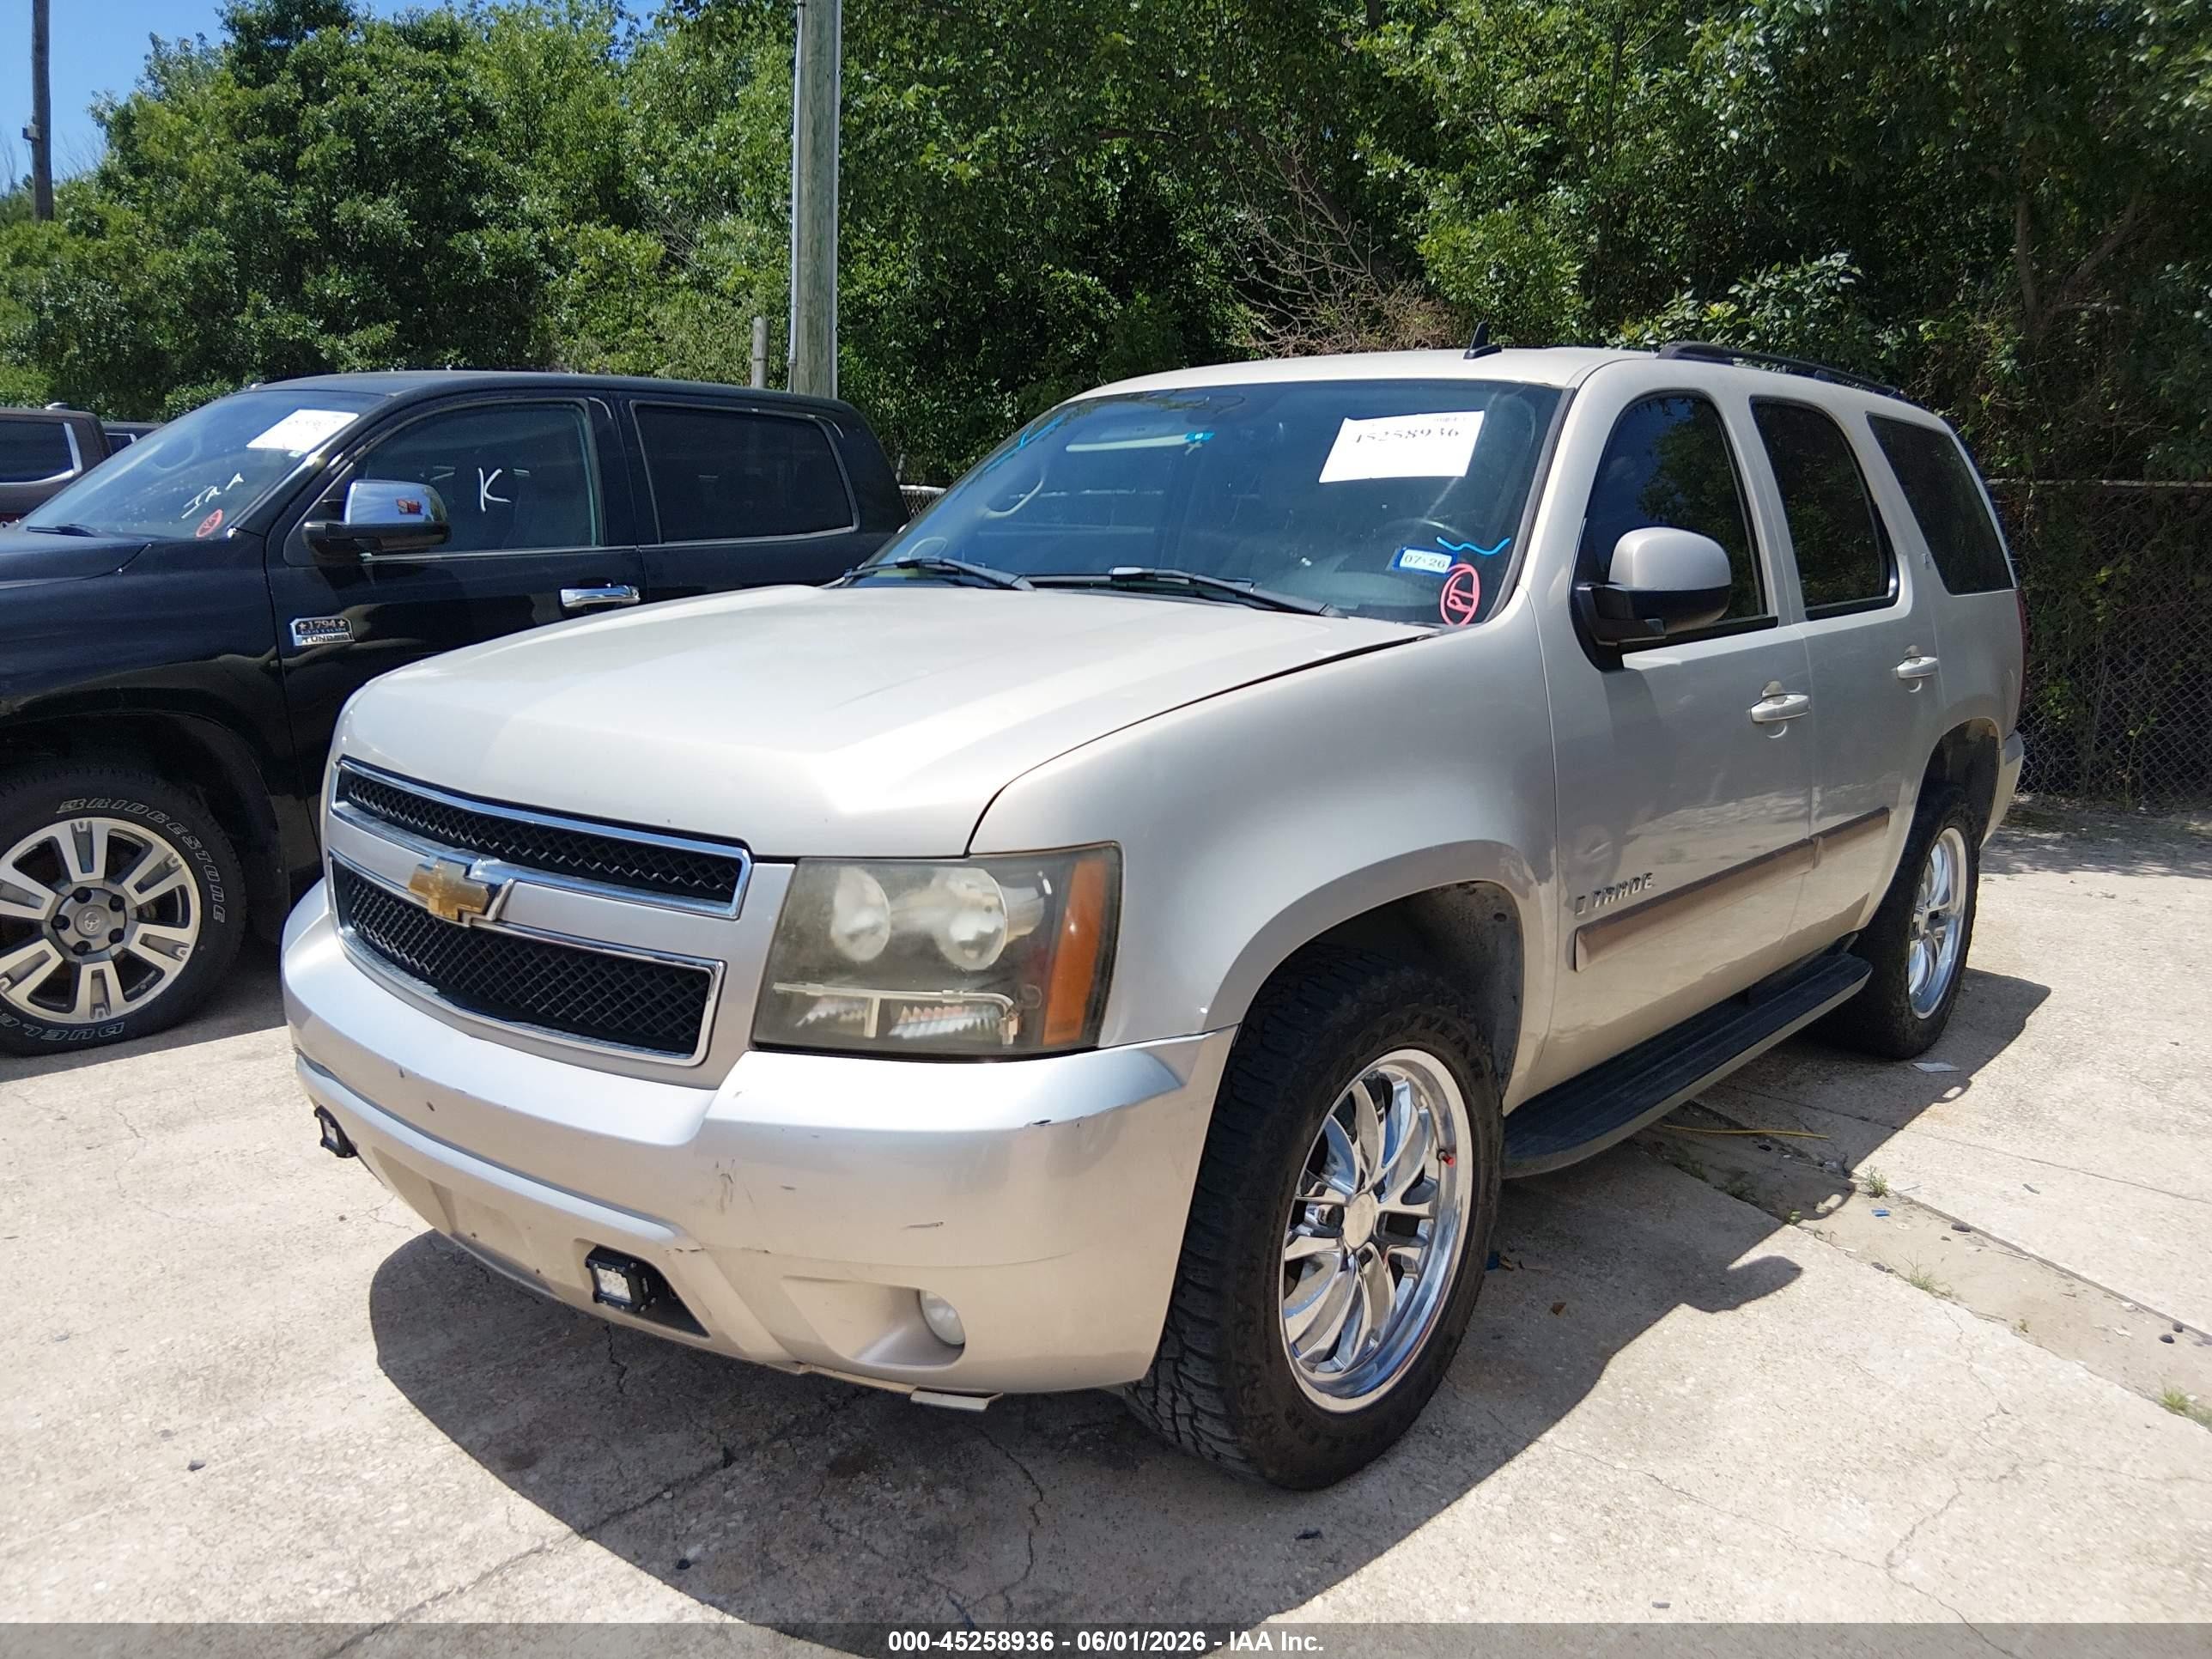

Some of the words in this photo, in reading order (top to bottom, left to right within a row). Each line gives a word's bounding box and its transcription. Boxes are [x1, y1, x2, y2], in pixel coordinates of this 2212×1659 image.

[477, 467, 512, 513] K
[307, 619, 337, 629] 1794
[56, 798, 226, 923] BRIDGESTONE
[1593, 872, 1653, 908] TAHOE
[0, 1013, 125, 1042] DUELE
